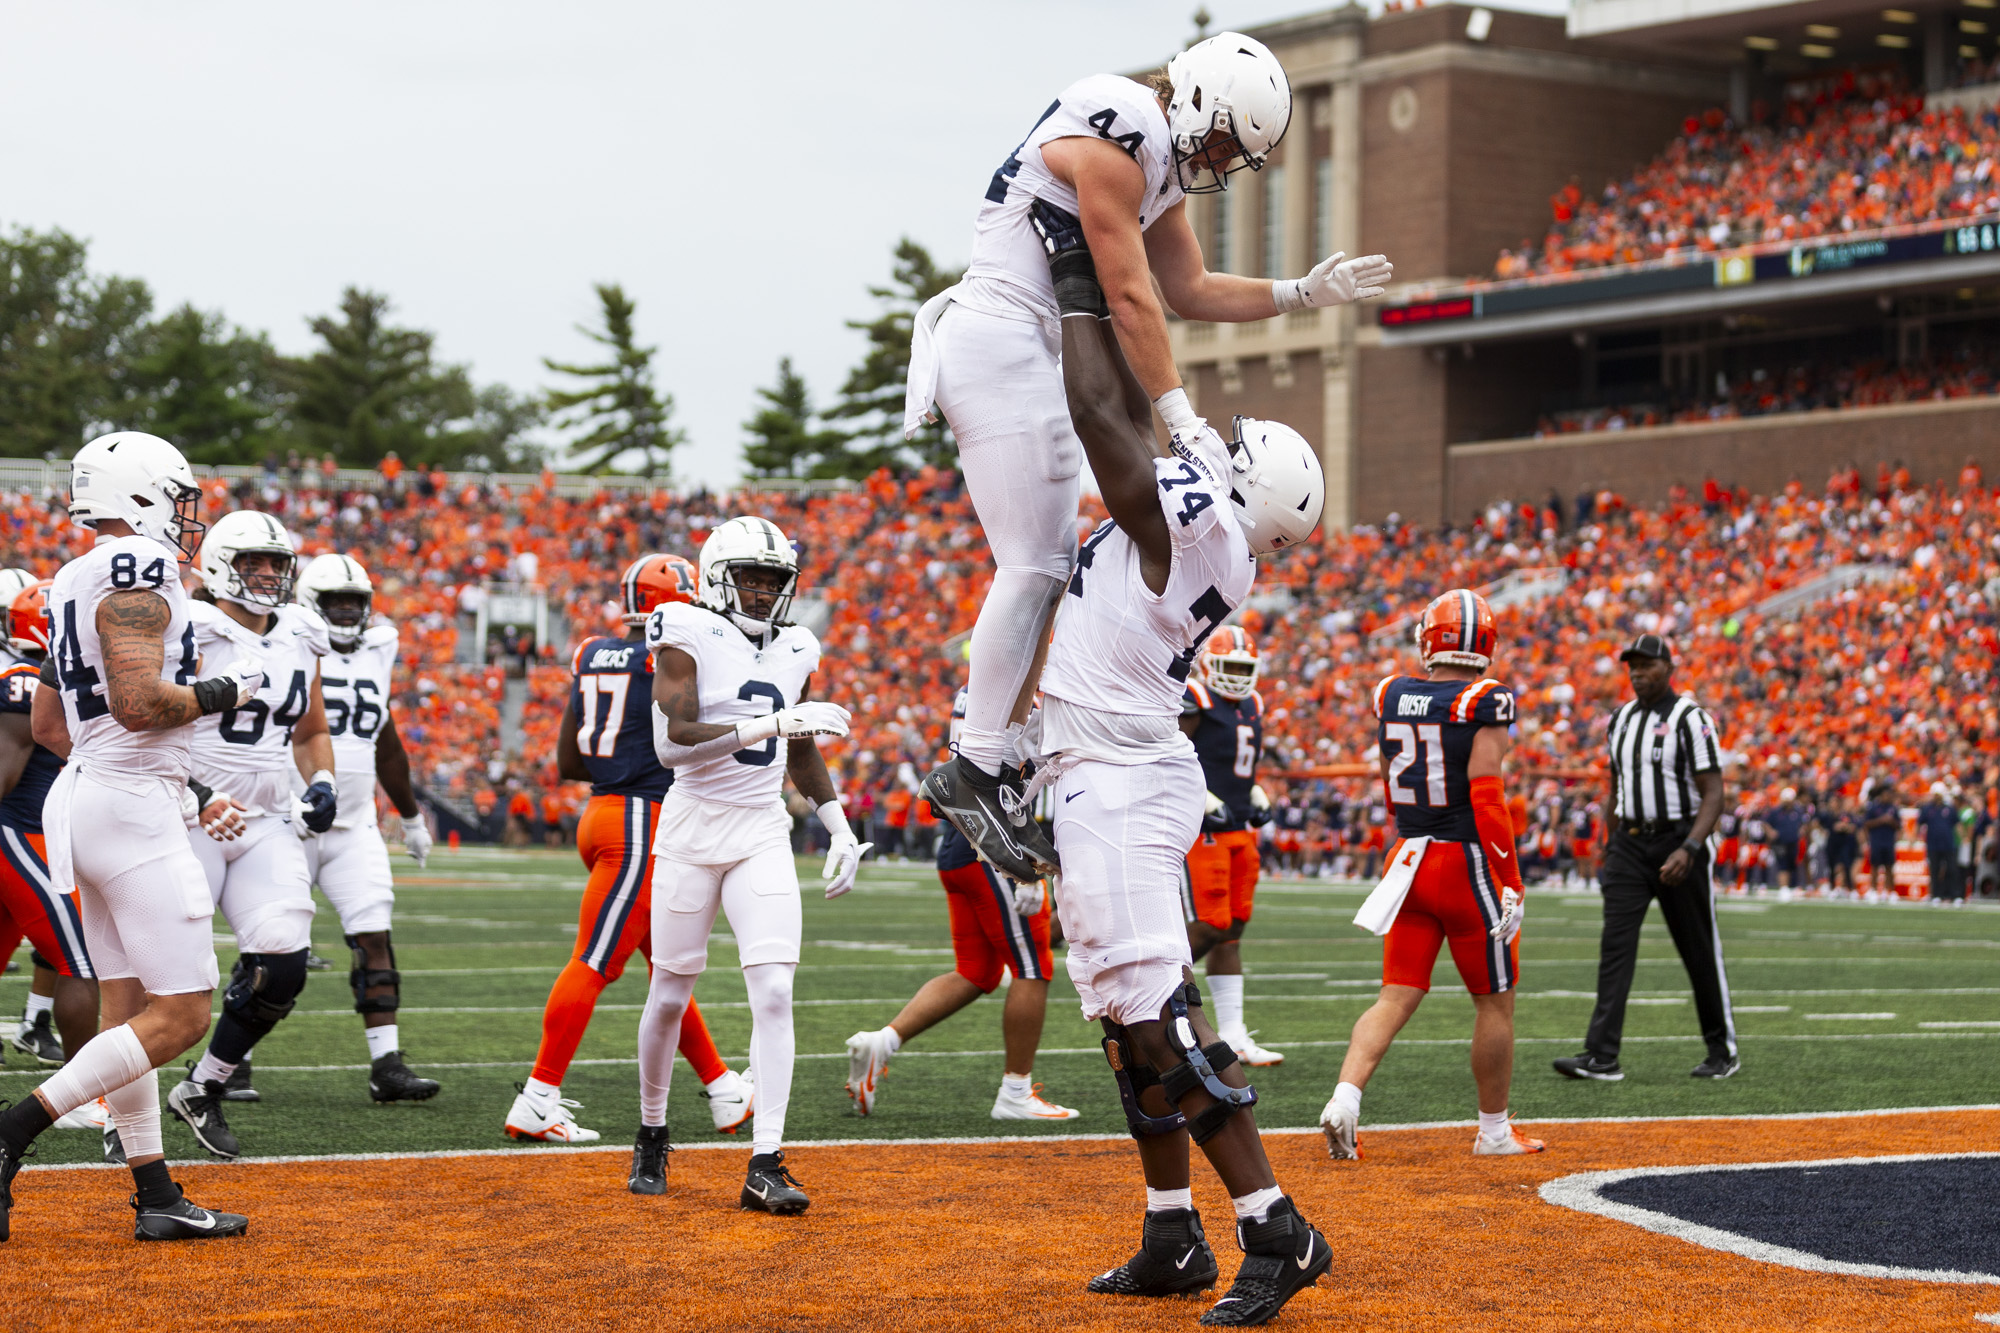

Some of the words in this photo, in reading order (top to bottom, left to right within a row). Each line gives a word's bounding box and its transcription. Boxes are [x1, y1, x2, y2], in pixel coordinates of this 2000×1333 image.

[1088, 107, 1146, 159] 44
[1173, 432, 1194, 460] PENN
[1192, 456, 1215, 483] STATE
[1159, 462, 1215, 528] 74
[111, 552, 165, 589] 84
[650, 611, 664, 642] 3
[9, 675, 41, 703] 39
[218, 669, 308, 747] 64
[321, 676, 382, 739] 56
[577, 671, 633, 758] 17
[1397, 693, 1433, 717] BUSH
[1493, 692, 1515, 722] 21
[732, 679, 785, 767] 3
[787, 729, 814, 738] PENN
[814, 728, 842, 737] STATE
[1233, 724, 1257, 779] 6
[1384, 721, 1449, 808] 21
[961, 813, 978, 837] ALPHA
[1402, 850, 1417, 867] I
